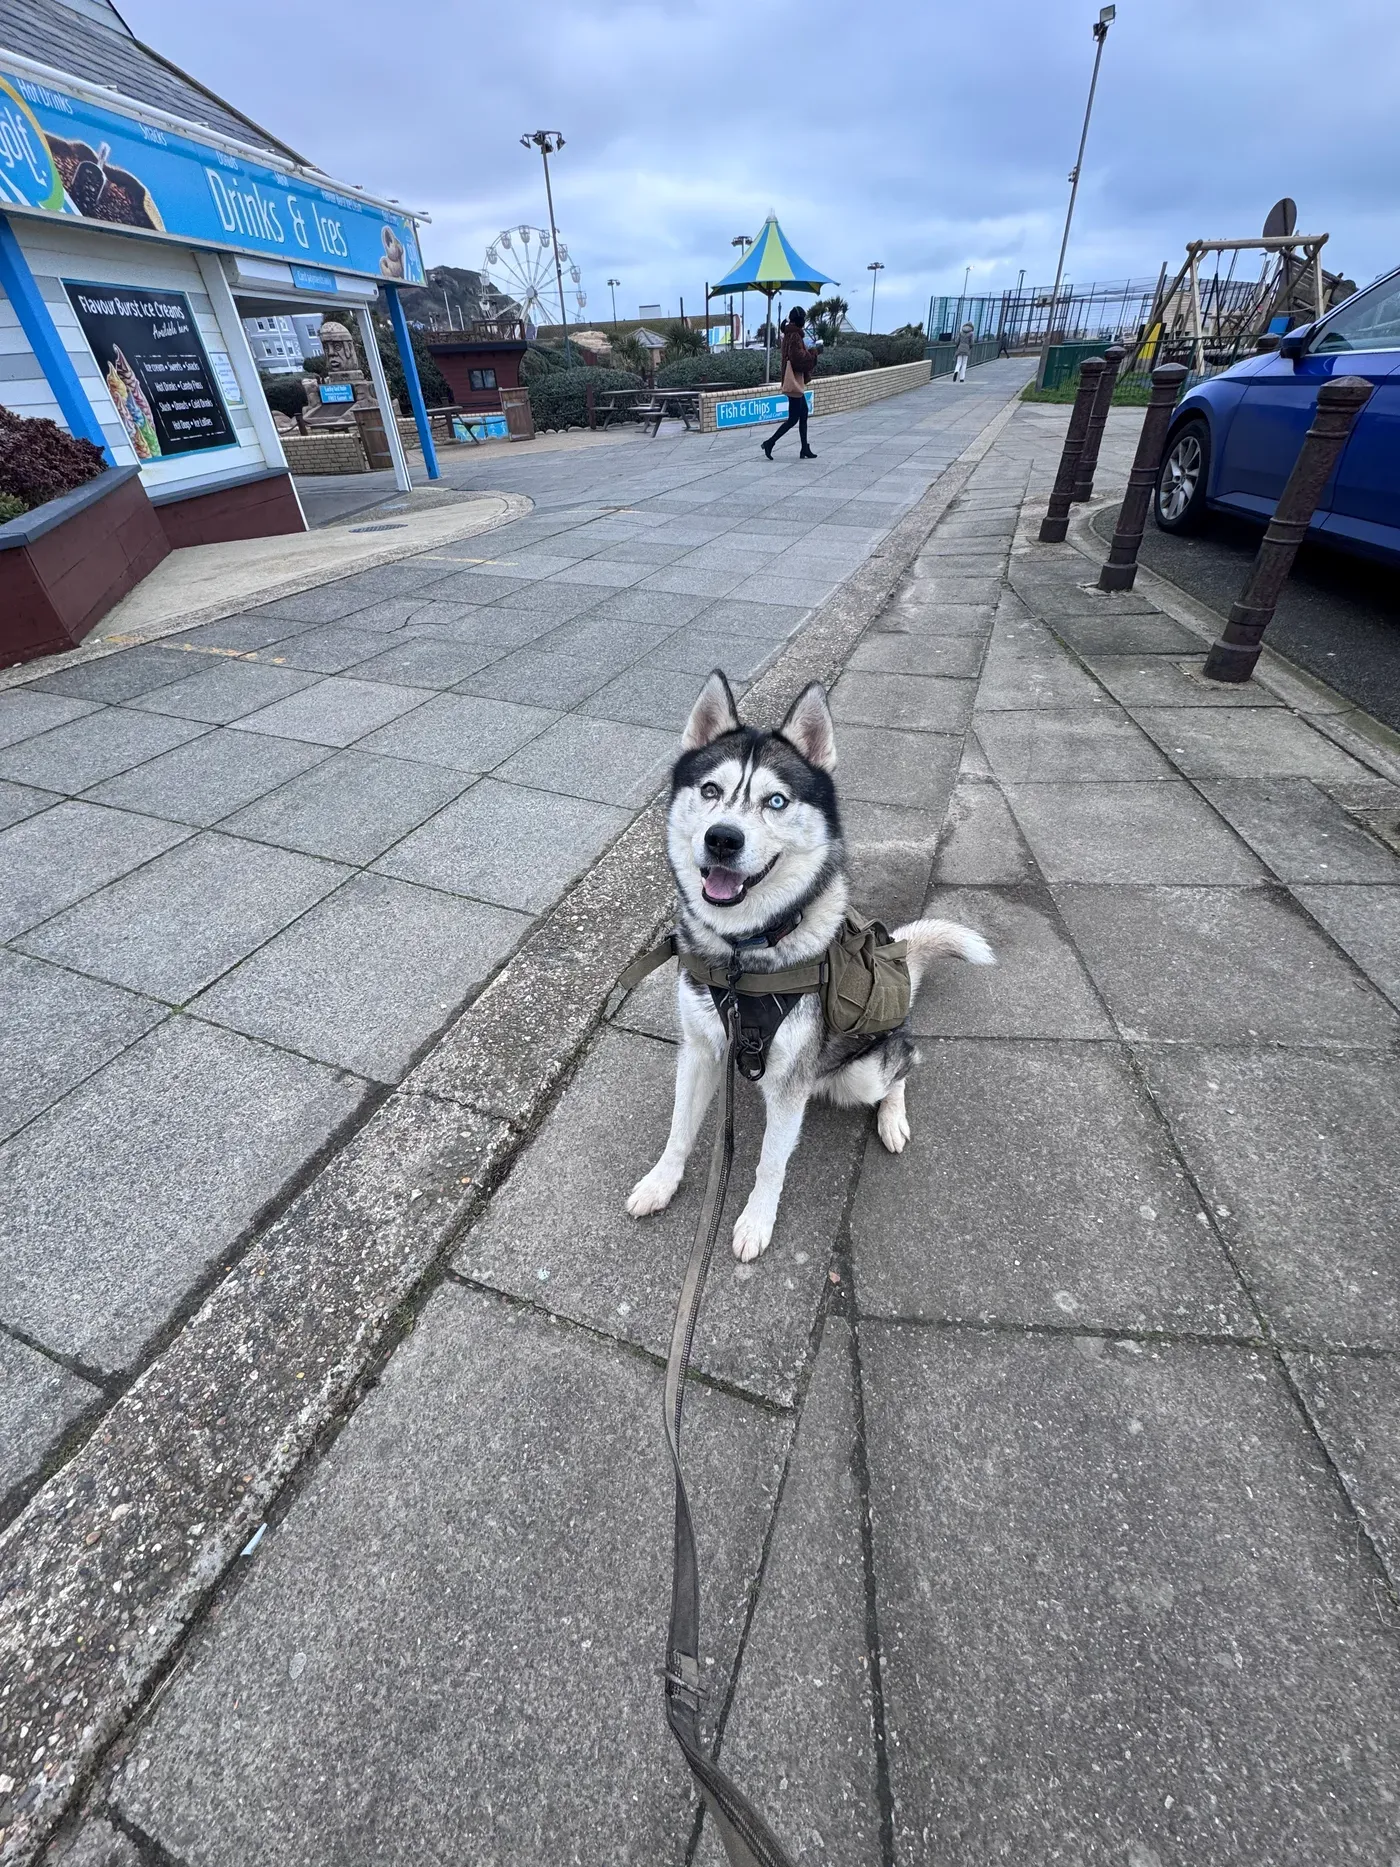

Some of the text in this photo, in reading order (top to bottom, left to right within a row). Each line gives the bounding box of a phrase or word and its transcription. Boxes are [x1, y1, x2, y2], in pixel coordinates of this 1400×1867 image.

[16, 78, 73, 115] Hot Drinks
[138, 122, 167, 146] Snacks
[205, 167, 348, 258] Drinks & Ices
[78, 295, 185, 320] Flavour Burst Ice Creams
[152, 321, 190, 340] Available here
[167, 361, 184, 372] Sweets
[184, 361, 201, 371] Snacks
[154, 379, 204, 392] Hot Drinks Candy Floss
[158, 397, 214, 412] Slush Donuts Cold Drinks
[720, 401, 770, 420] Fish & Chips
[171, 420, 182, 431] Hot
[180, 419, 192, 431] Dogs
[192, 418, 201, 428] Ice
